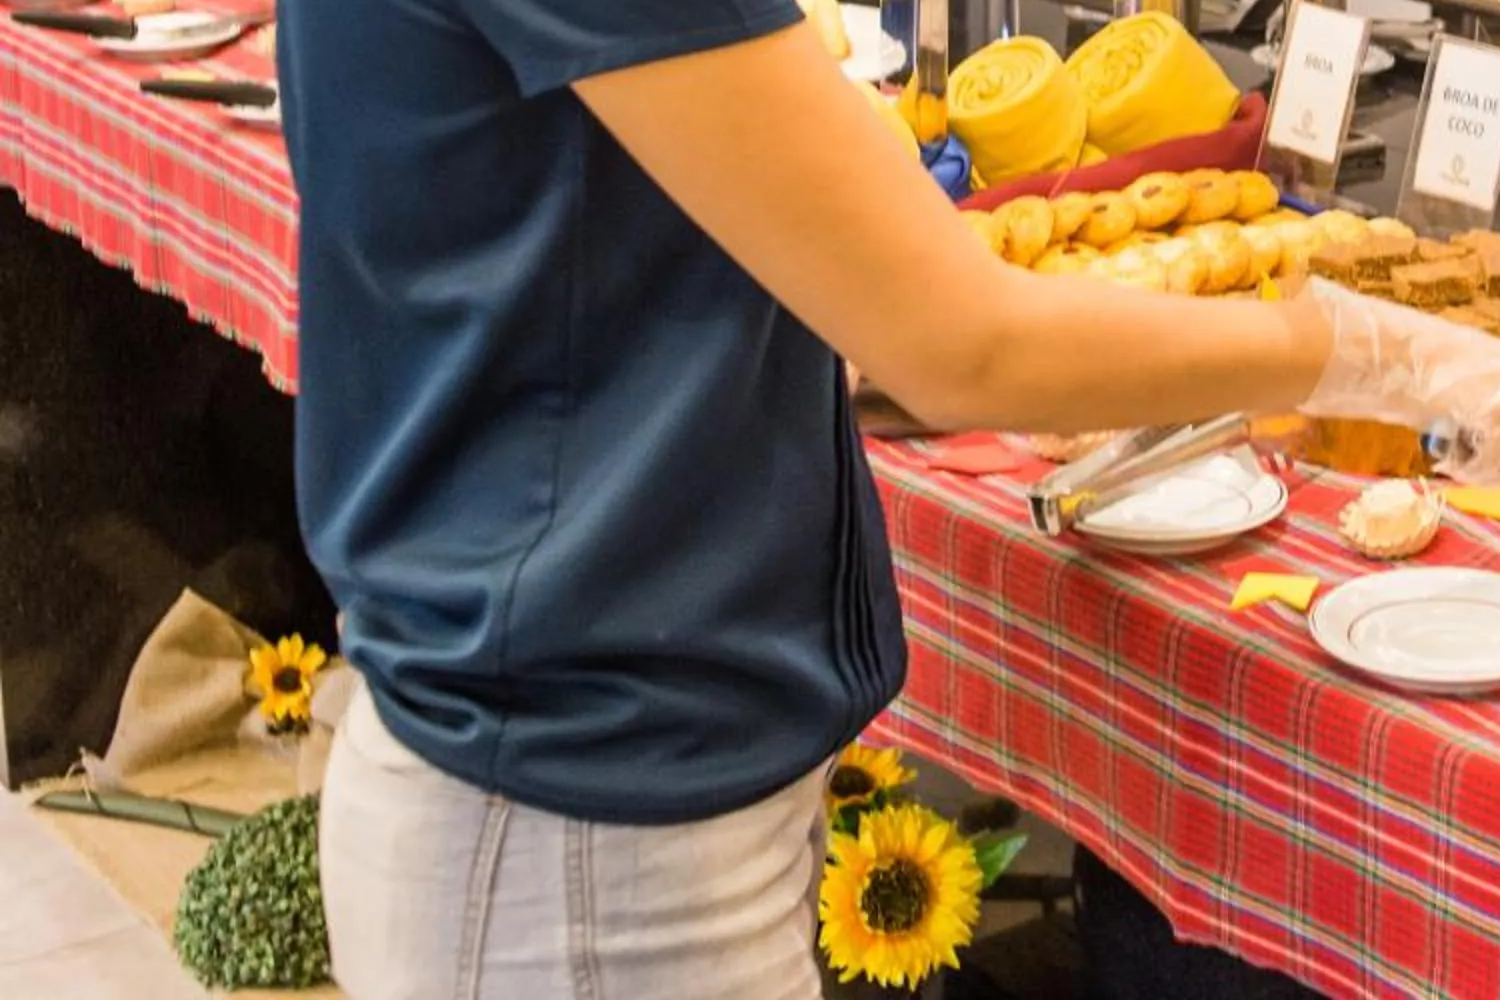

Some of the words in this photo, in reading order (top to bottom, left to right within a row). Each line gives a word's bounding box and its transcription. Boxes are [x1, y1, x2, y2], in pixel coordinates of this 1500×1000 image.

[1443, 86, 1479, 109] BROA
[1482, 97, 1498, 116] DE
[1448, 115, 1484, 138] COCO
